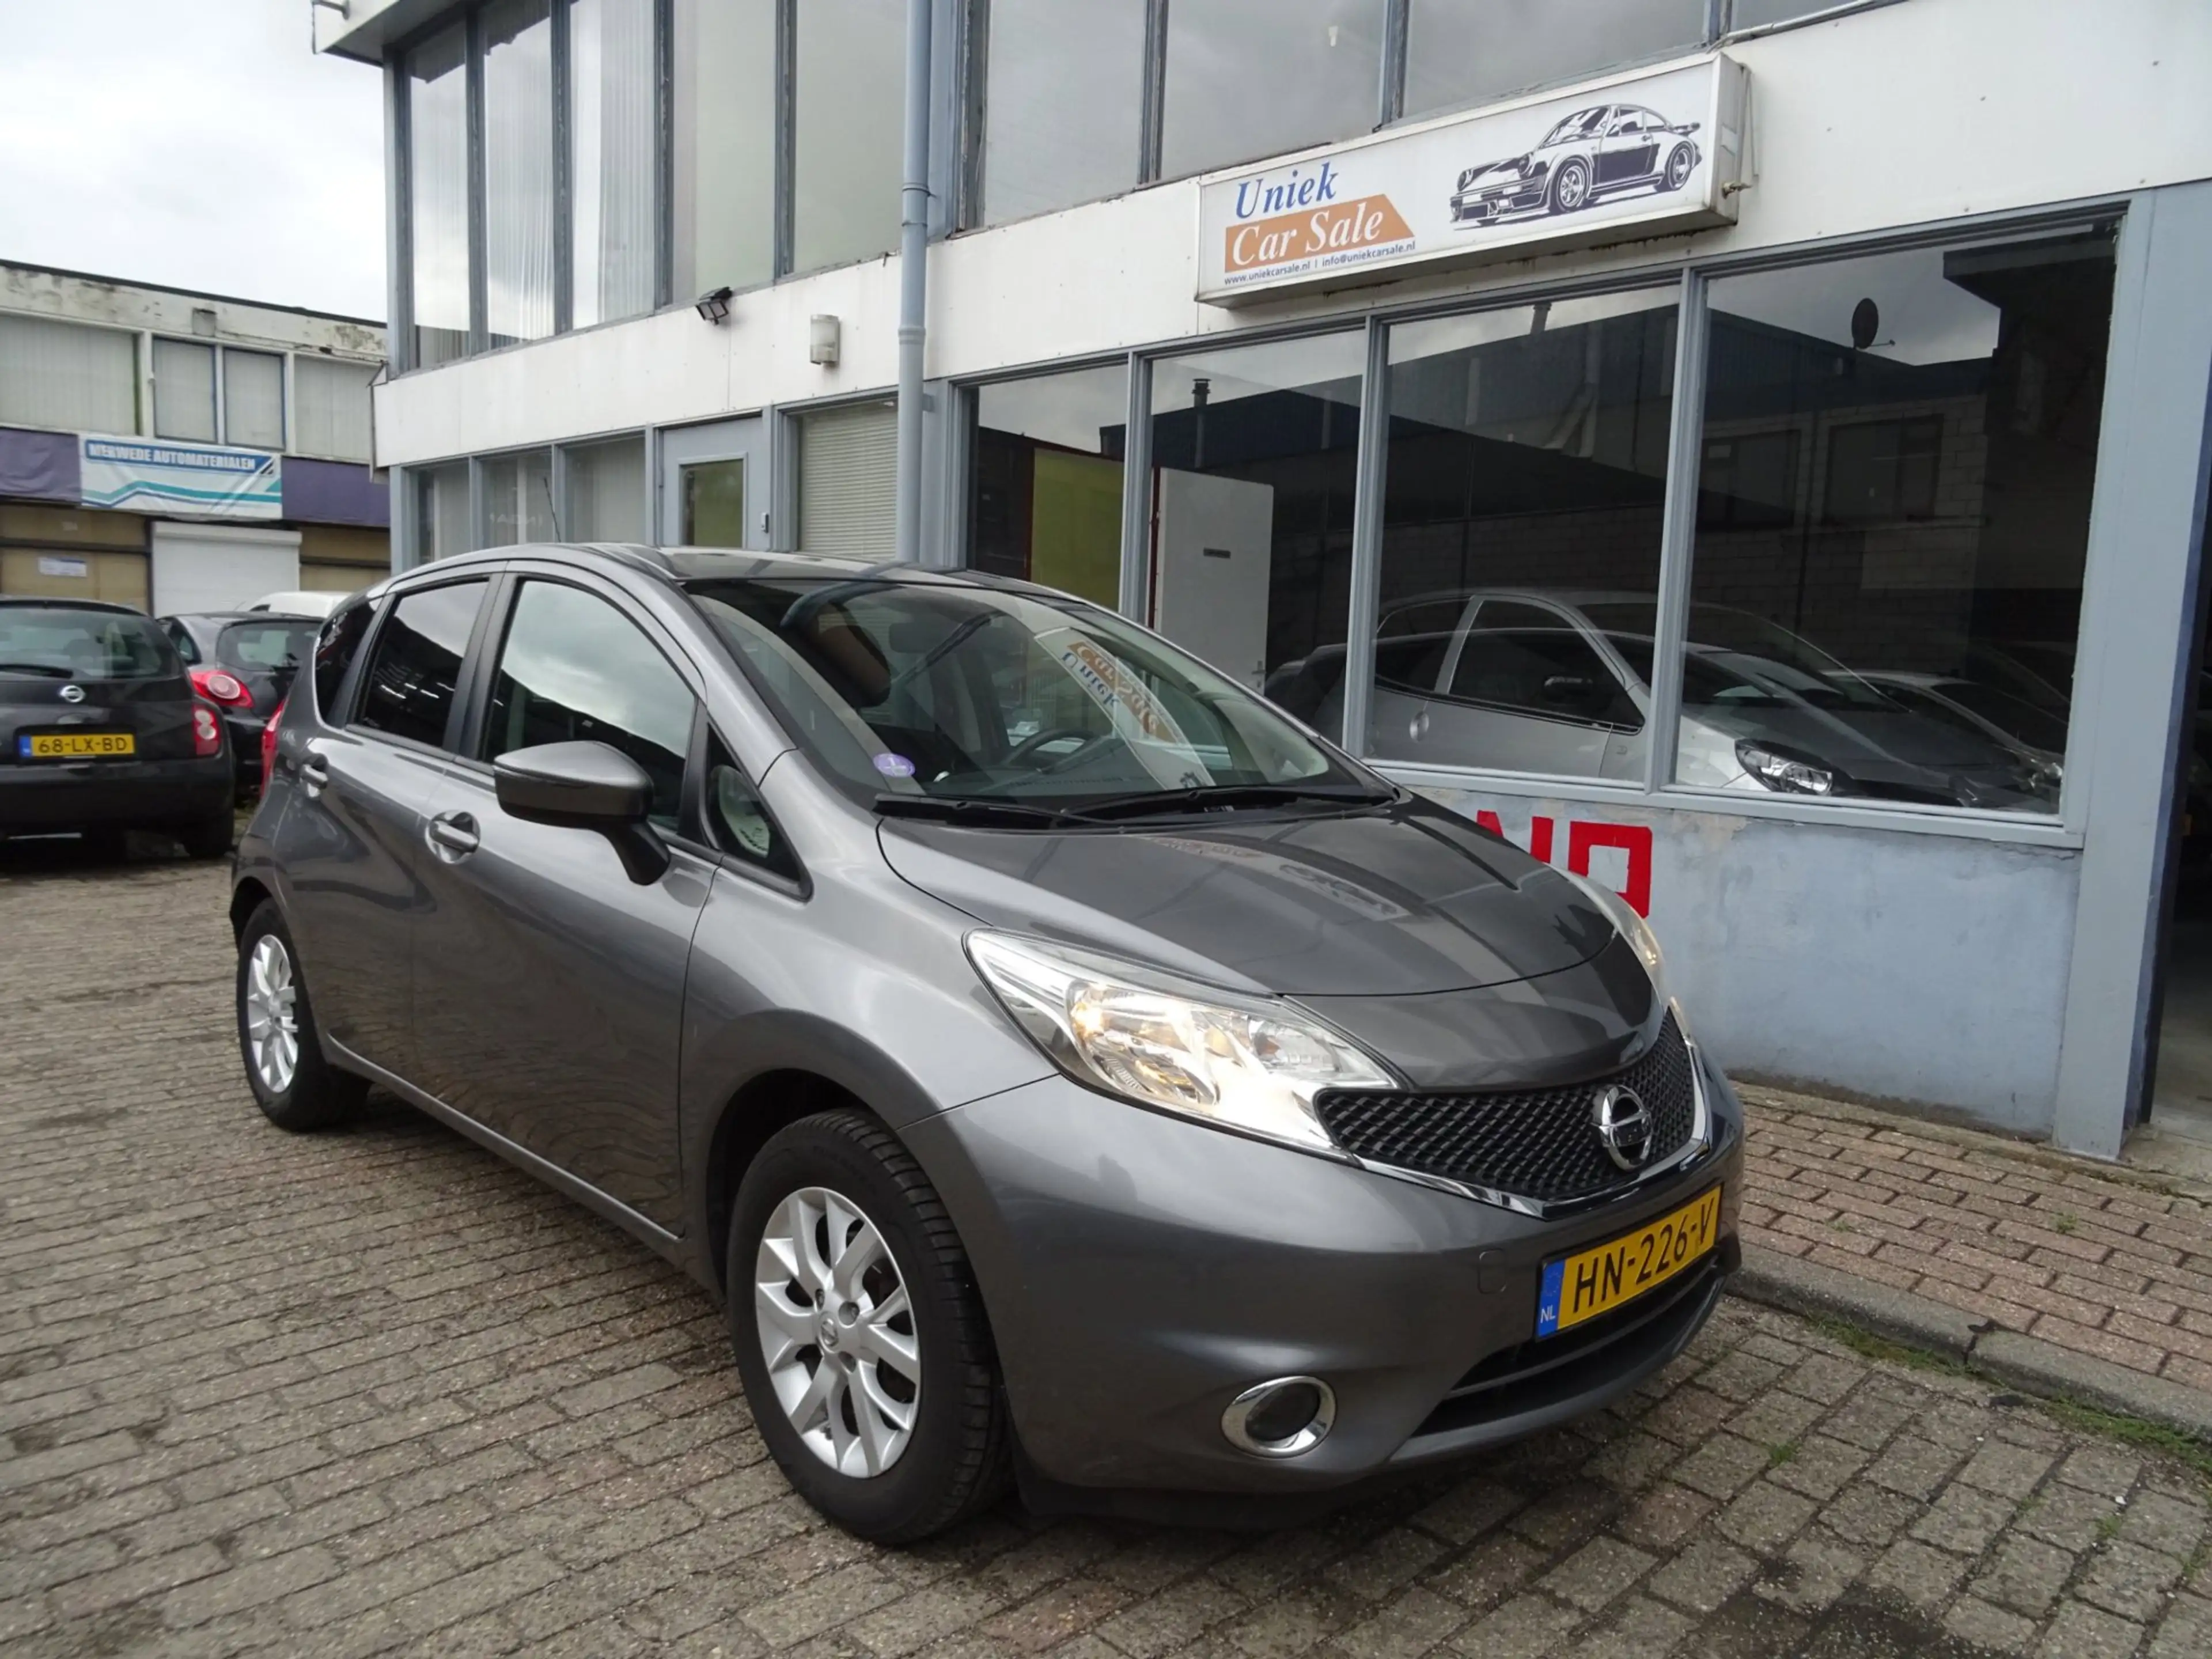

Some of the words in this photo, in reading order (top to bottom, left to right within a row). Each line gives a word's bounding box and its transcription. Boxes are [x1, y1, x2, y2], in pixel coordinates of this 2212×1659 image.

[1236, 162, 1339, 219] Uniek
[1232, 225, 1298, 266] Car
[1305, 202, 1383, 253] Sale
[1224, 260, 1310, 285] www.uniekcarsale.nl
[1321, 241, 1416, 268] info@uniekcarsale.nl
[153, 450, 255, 470] AUTOMATERIALEN
[38, 737, 127, 753] 68-LX-BD
[1573, 1196, 1715, 1313] HN-226-V
[1540, 1305, 1556, 1324] NL
